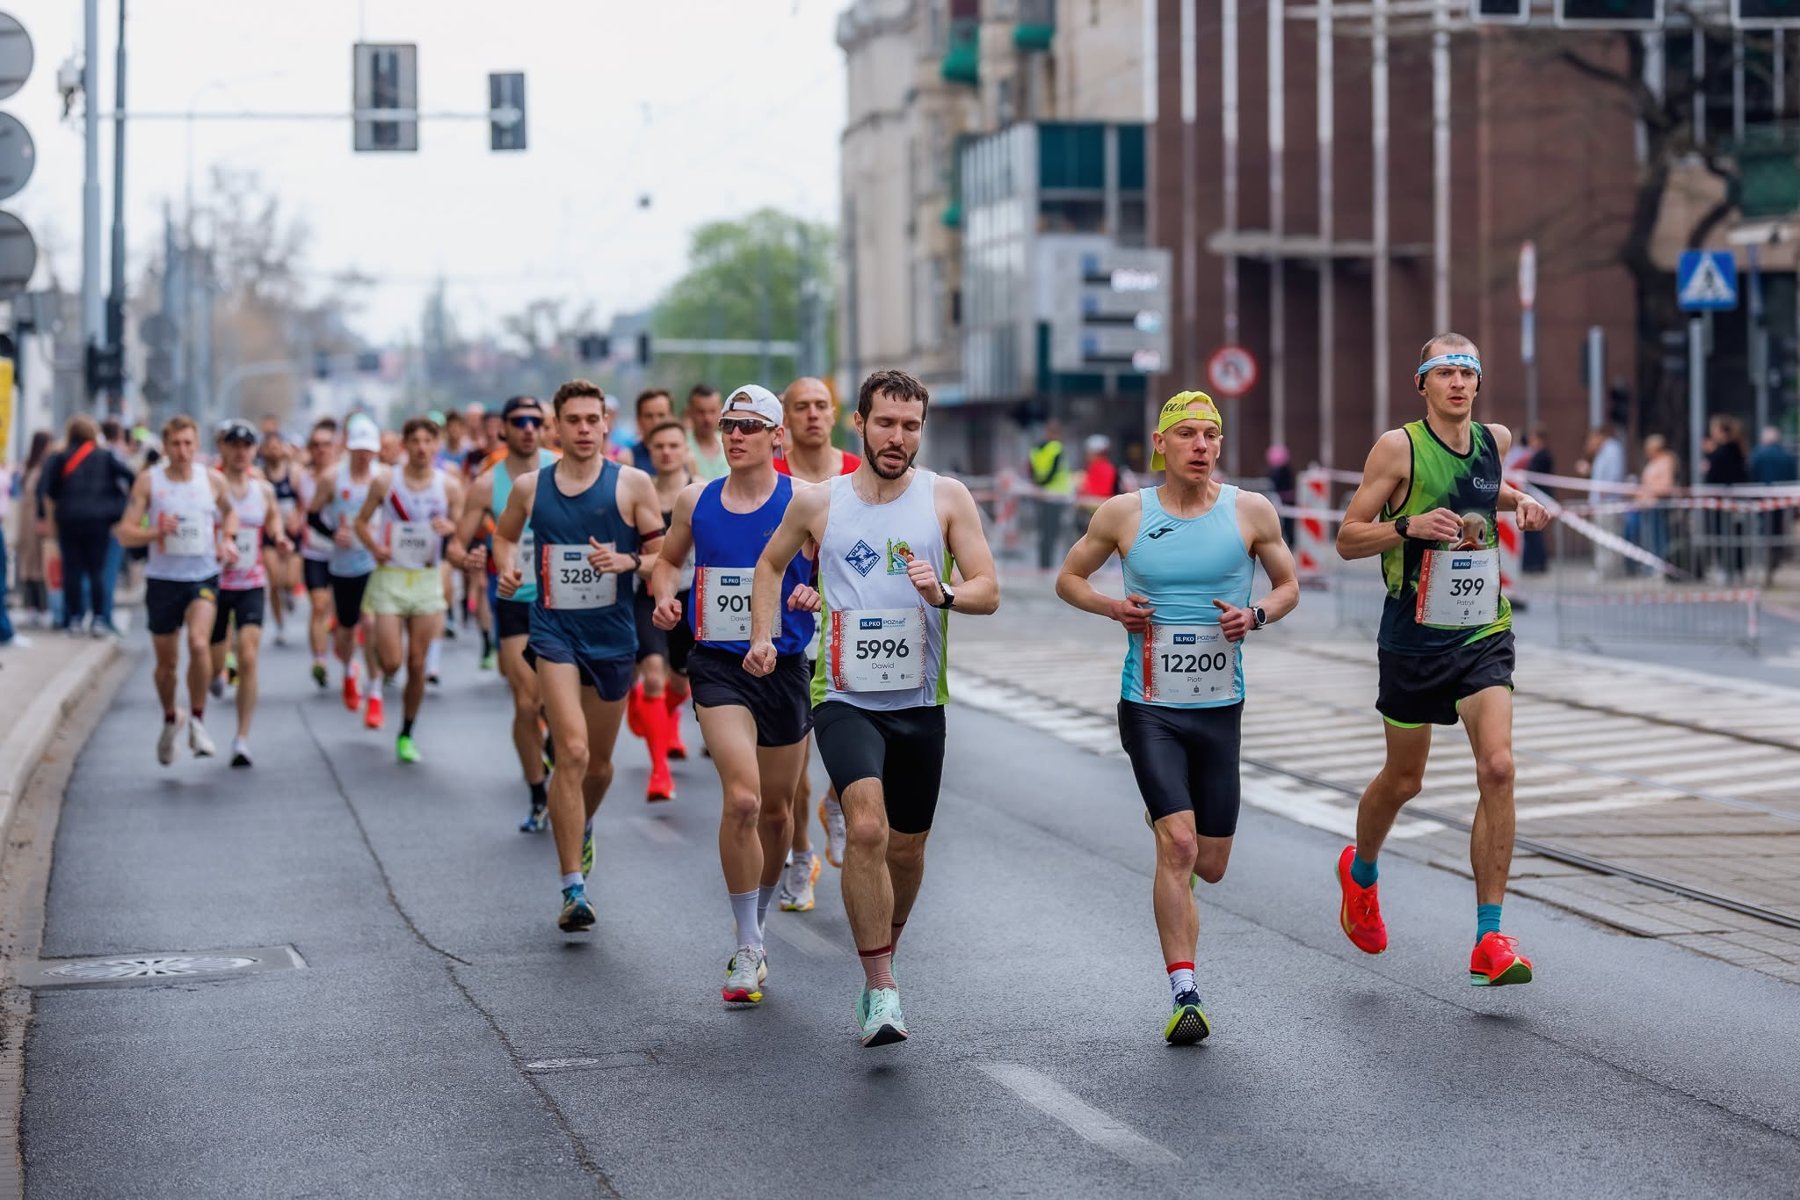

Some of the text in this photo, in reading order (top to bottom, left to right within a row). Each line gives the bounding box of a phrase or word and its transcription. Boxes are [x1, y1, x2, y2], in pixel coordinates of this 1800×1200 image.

[560, 568, 602, 584] 3289
[1449, 578, 1484, 596] 399
[717, 595, 752, 612] 901
[861, 620, 881, 628] 18.PKO
[856, 638, 910, 660] 5996
[871, 662, 895, 670] Dawid
[1160, 652, 1227, 673] 12200
